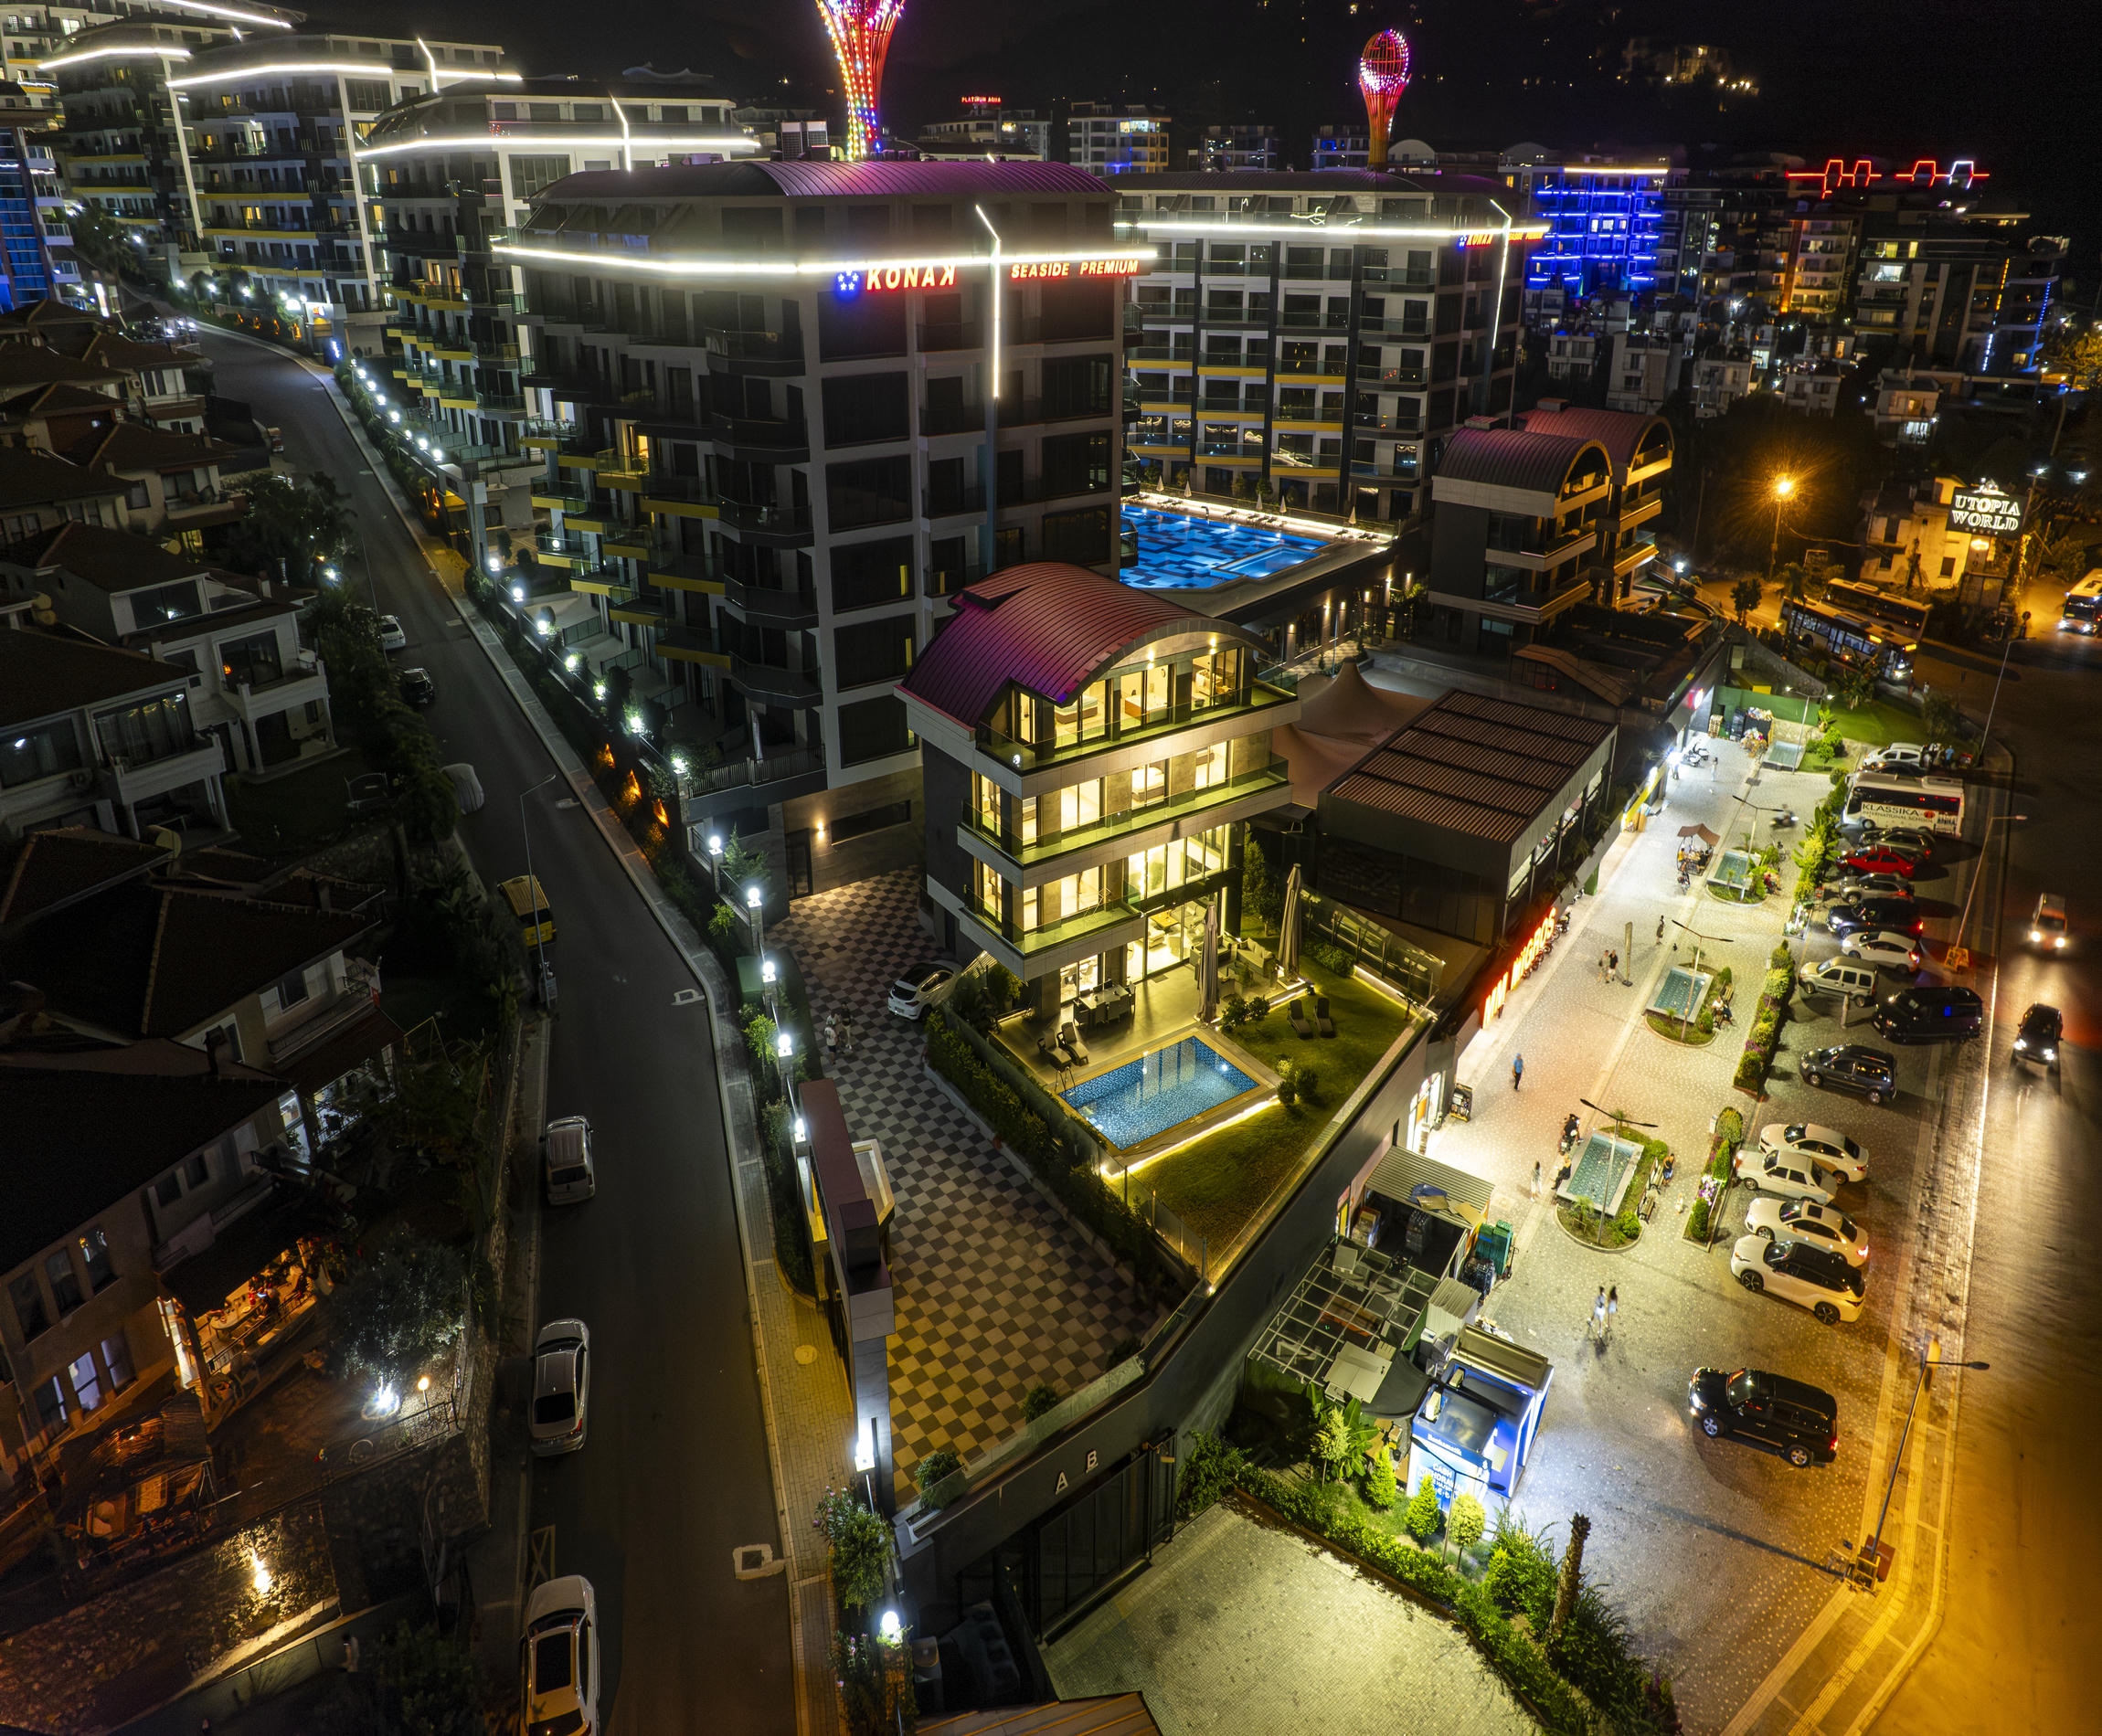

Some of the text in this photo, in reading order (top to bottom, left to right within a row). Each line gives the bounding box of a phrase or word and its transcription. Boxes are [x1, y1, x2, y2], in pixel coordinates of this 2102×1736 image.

[866, 265, 957, 291] KONAK
[1011, 259, 1139, 279] SEASIDE PREMIUM
[1954, 494, 2021, 516] UTOPIA
[1951, 510, 2019, 531] WORLD
[1863, 803, 1919, 817] KLASSIKA
[1055, 1450, 1099, 1496] A B
